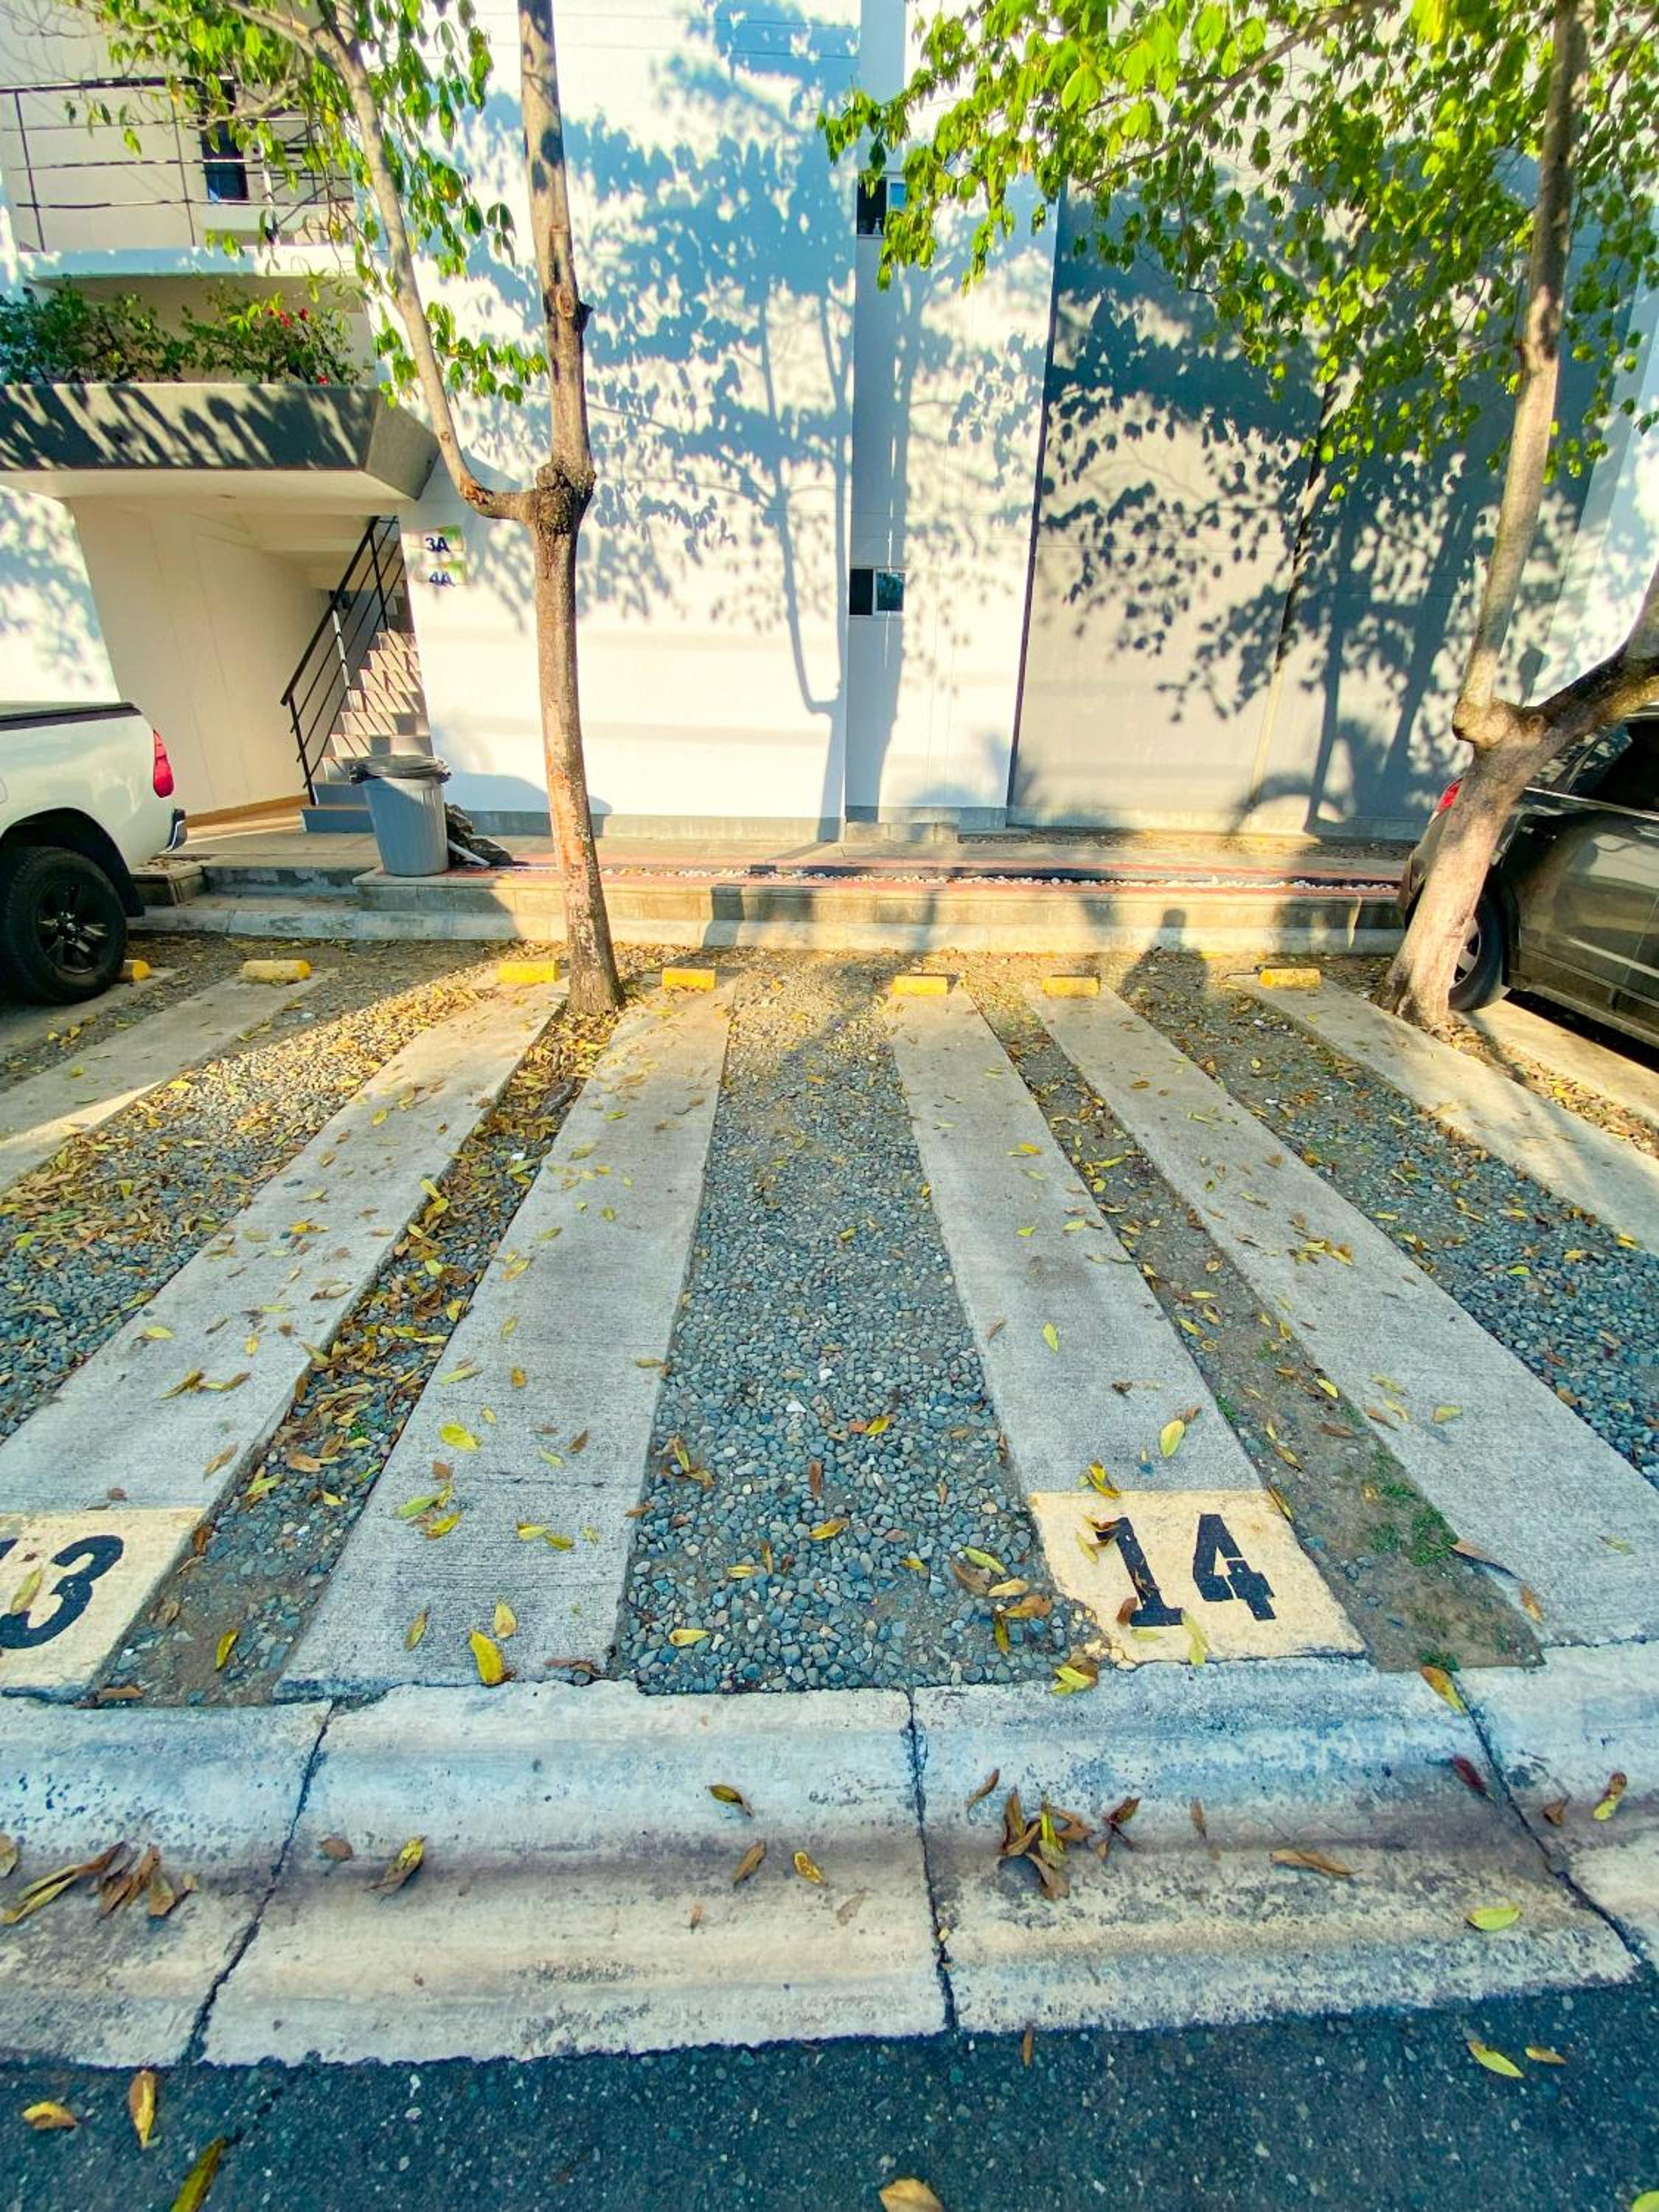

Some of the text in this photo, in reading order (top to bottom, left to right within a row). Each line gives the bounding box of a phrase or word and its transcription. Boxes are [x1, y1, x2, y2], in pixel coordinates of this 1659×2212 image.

[425, 537, 451, 552] 3A
[429, 571, 456, 587] 4A
[0, 1534, 124, 1649] 3
[1096, 1514, 1276, 1627] 14
